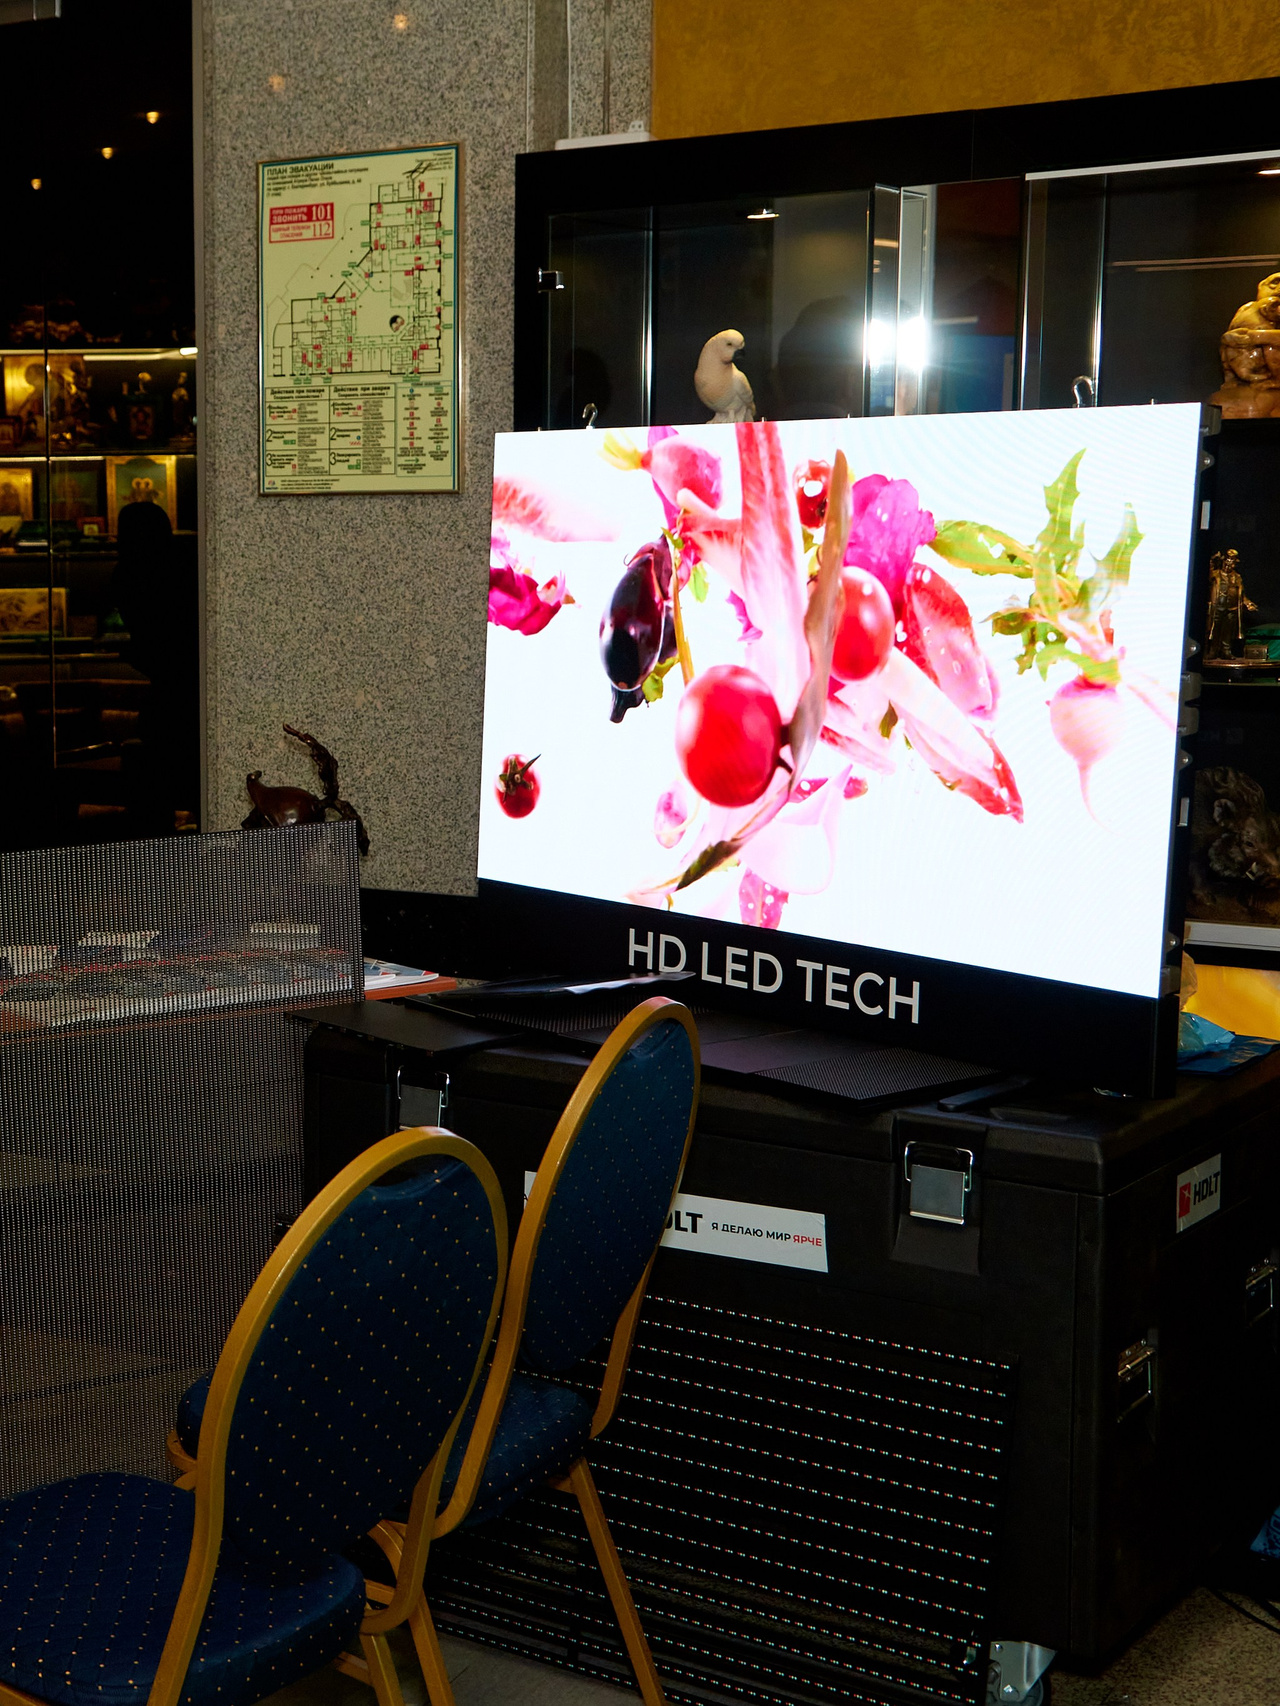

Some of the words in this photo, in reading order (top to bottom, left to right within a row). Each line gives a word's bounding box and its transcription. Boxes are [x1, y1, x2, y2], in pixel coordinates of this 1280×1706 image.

[267, 167, 288, 176] ПЛАН
[289, 163, 334, 174] ЭВАКУАЦИИ
[272, 213, 308, 223] ЗВОНИТЬ
[311, 204, 332, 220] 101
[312, 222, 331, 237] 112
[628, 928, 687, 973] HD
[701, 941, 783, 993] LED
[796, 958, 920, 1024] TECH
[1193, 1171, 1220, 1206] HDLT
[711, 1222, 719, 1231] Я
[721, 1223, 763, 1238] ДЕЛАЮ
[766, 1230, 791, 1241] МИР
[793, 1234, 822, 1247] ЯРЧЕ
